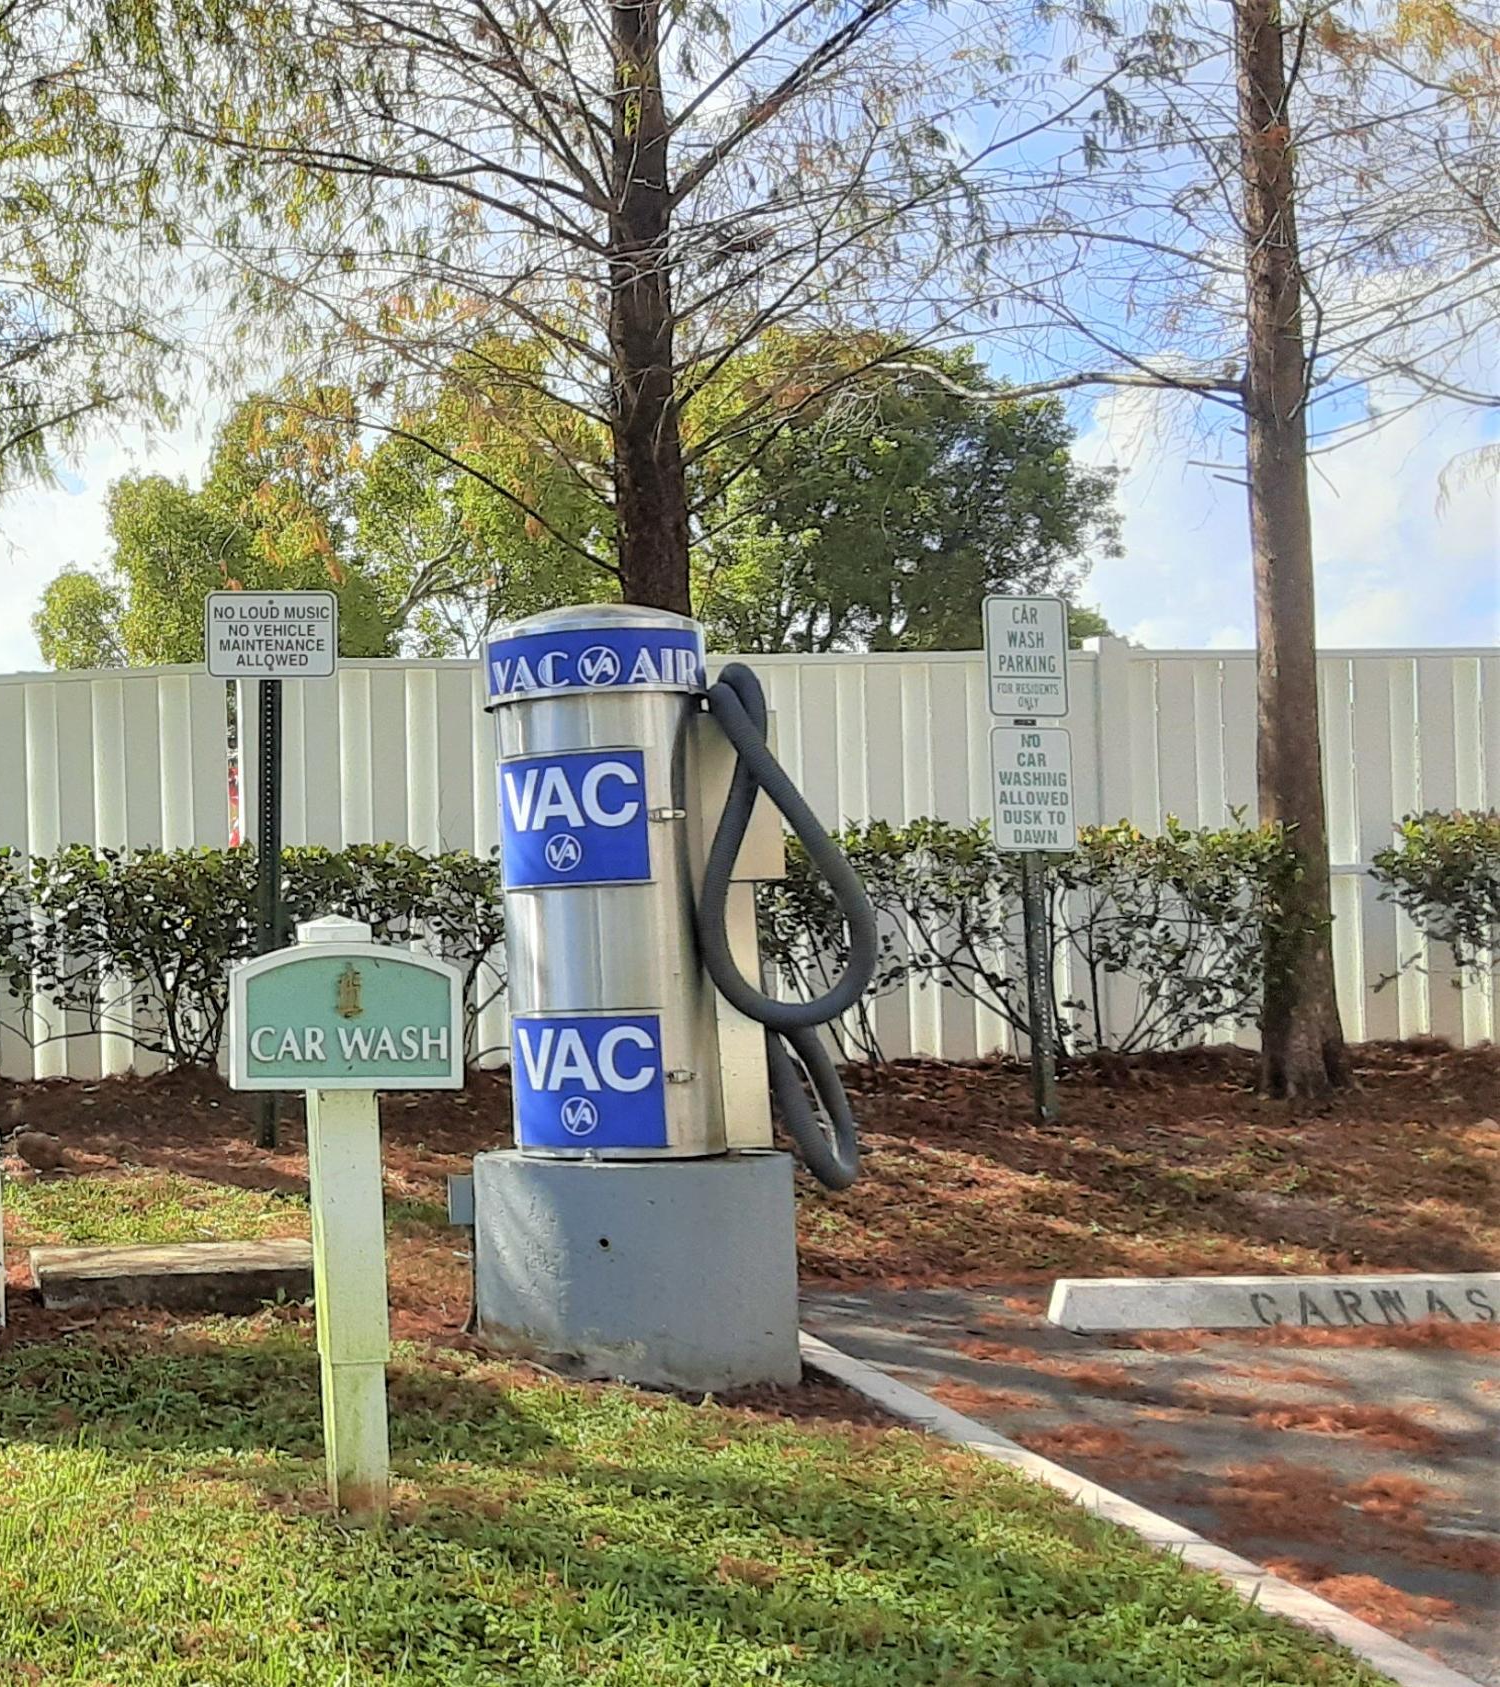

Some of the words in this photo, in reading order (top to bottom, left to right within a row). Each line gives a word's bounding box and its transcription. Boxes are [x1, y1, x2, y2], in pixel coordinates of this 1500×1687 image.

[213, 606, 235, 619] NO
[239, 606, 279, 619] LOUD
[284, 606, 330, 619] MUSIC
[1011, 605, 1038, 625] CAR
[228, 624, 250, 637] NO
[254, 624, 316, 637] VEHICLE
[219, 639, 325, 652] MAINTENANCE
[1006, 630, 1044, 649] WASH
[236, 653, 309, 667] ALLOWED
[998, 654, 1057, 674] PARKING
[491, 651, 570, 694] VAC
[628, 647, 699, 685] AIR
[997, 683, 1014, 695] FOR
[1015, 683, 1059, 696] RESIDENTS
[1018, 696, 1040, 708] ONLY
[1020, 733, 1041, 749] NO
[1016, 752, 1047, 767] CAR
[998, 771, 1068, 787] WASHING
[504, 761, 639, 832] VAC
[999, 790, 1069, 806] ALLOWED
[1003, 809, 1043, 825] DUSK
[1047, 810, 1066, 826] TO
[1013, 829, 1058, 845] DAWN
[250, 1026, 327, 1062] CAR
[337, 1026, 449, 1062] WASH
[517, 1025, 656, 1092] VAC
